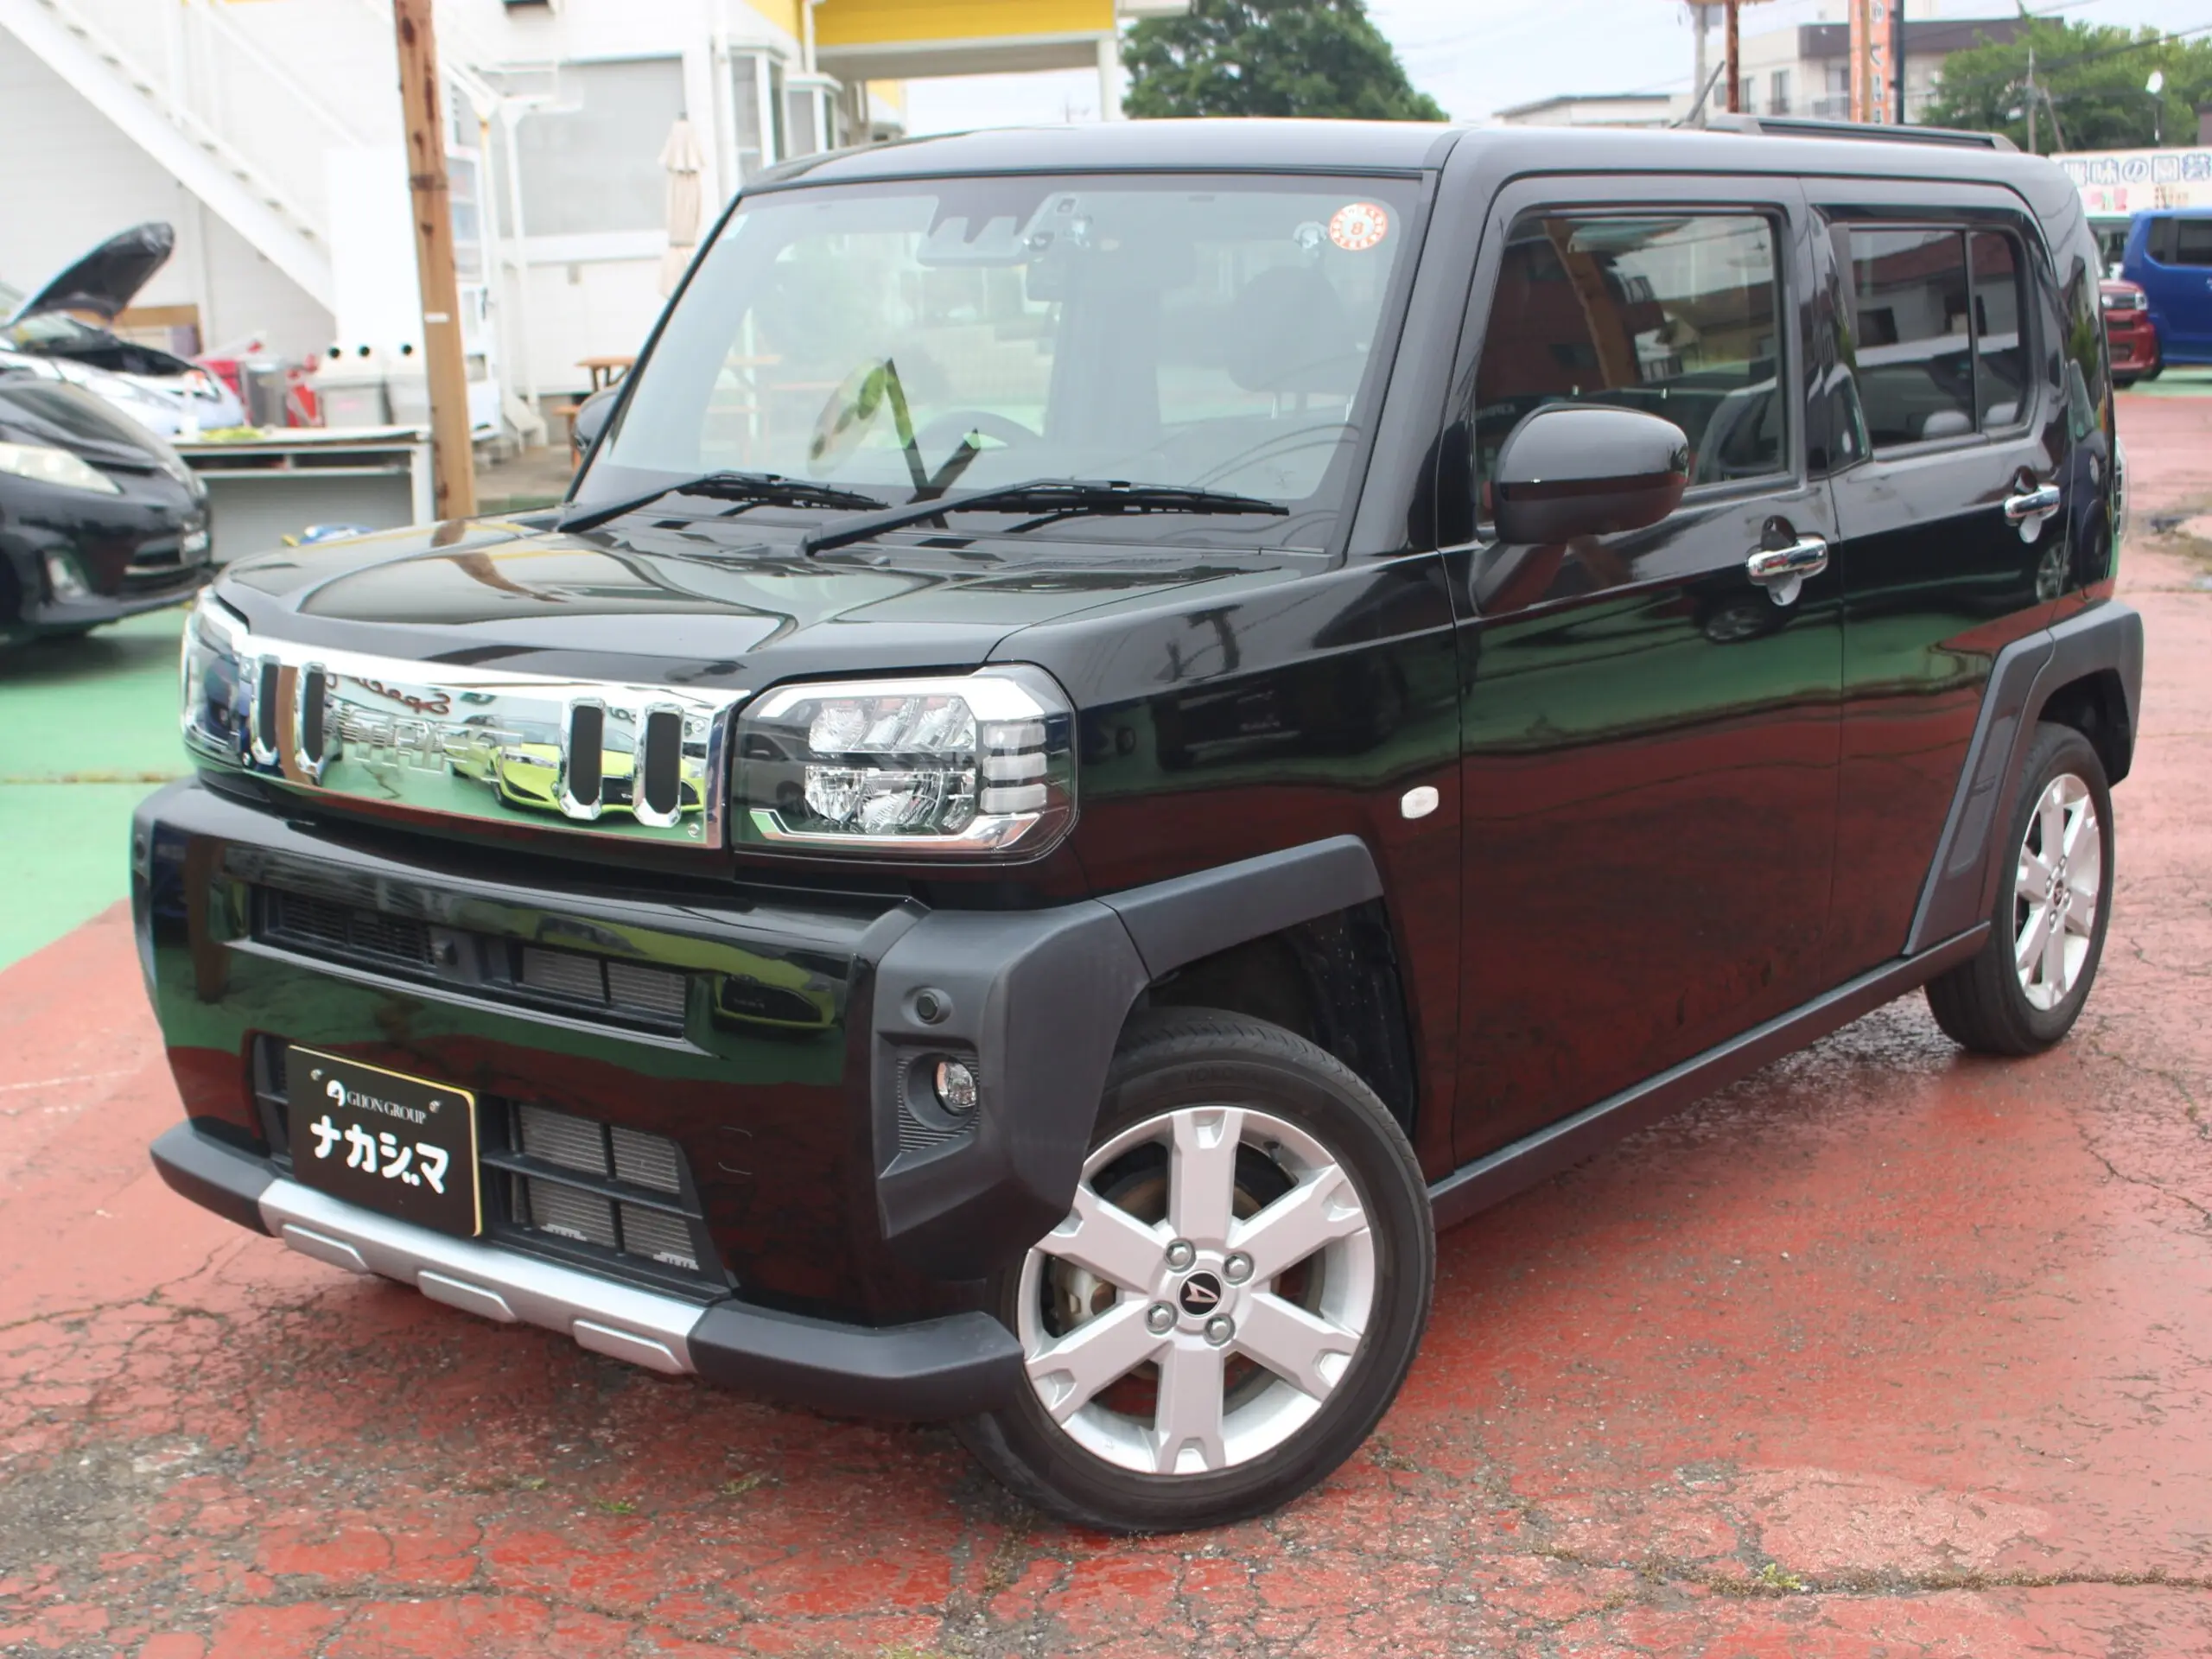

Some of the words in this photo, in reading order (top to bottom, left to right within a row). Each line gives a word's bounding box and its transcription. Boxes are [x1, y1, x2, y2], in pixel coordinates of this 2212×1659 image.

[346, 1091, 383, 1113] GLION
[385, 1101, 427, 1124] GROUP
[310, 1115, 449, 1194] ナカジマ
